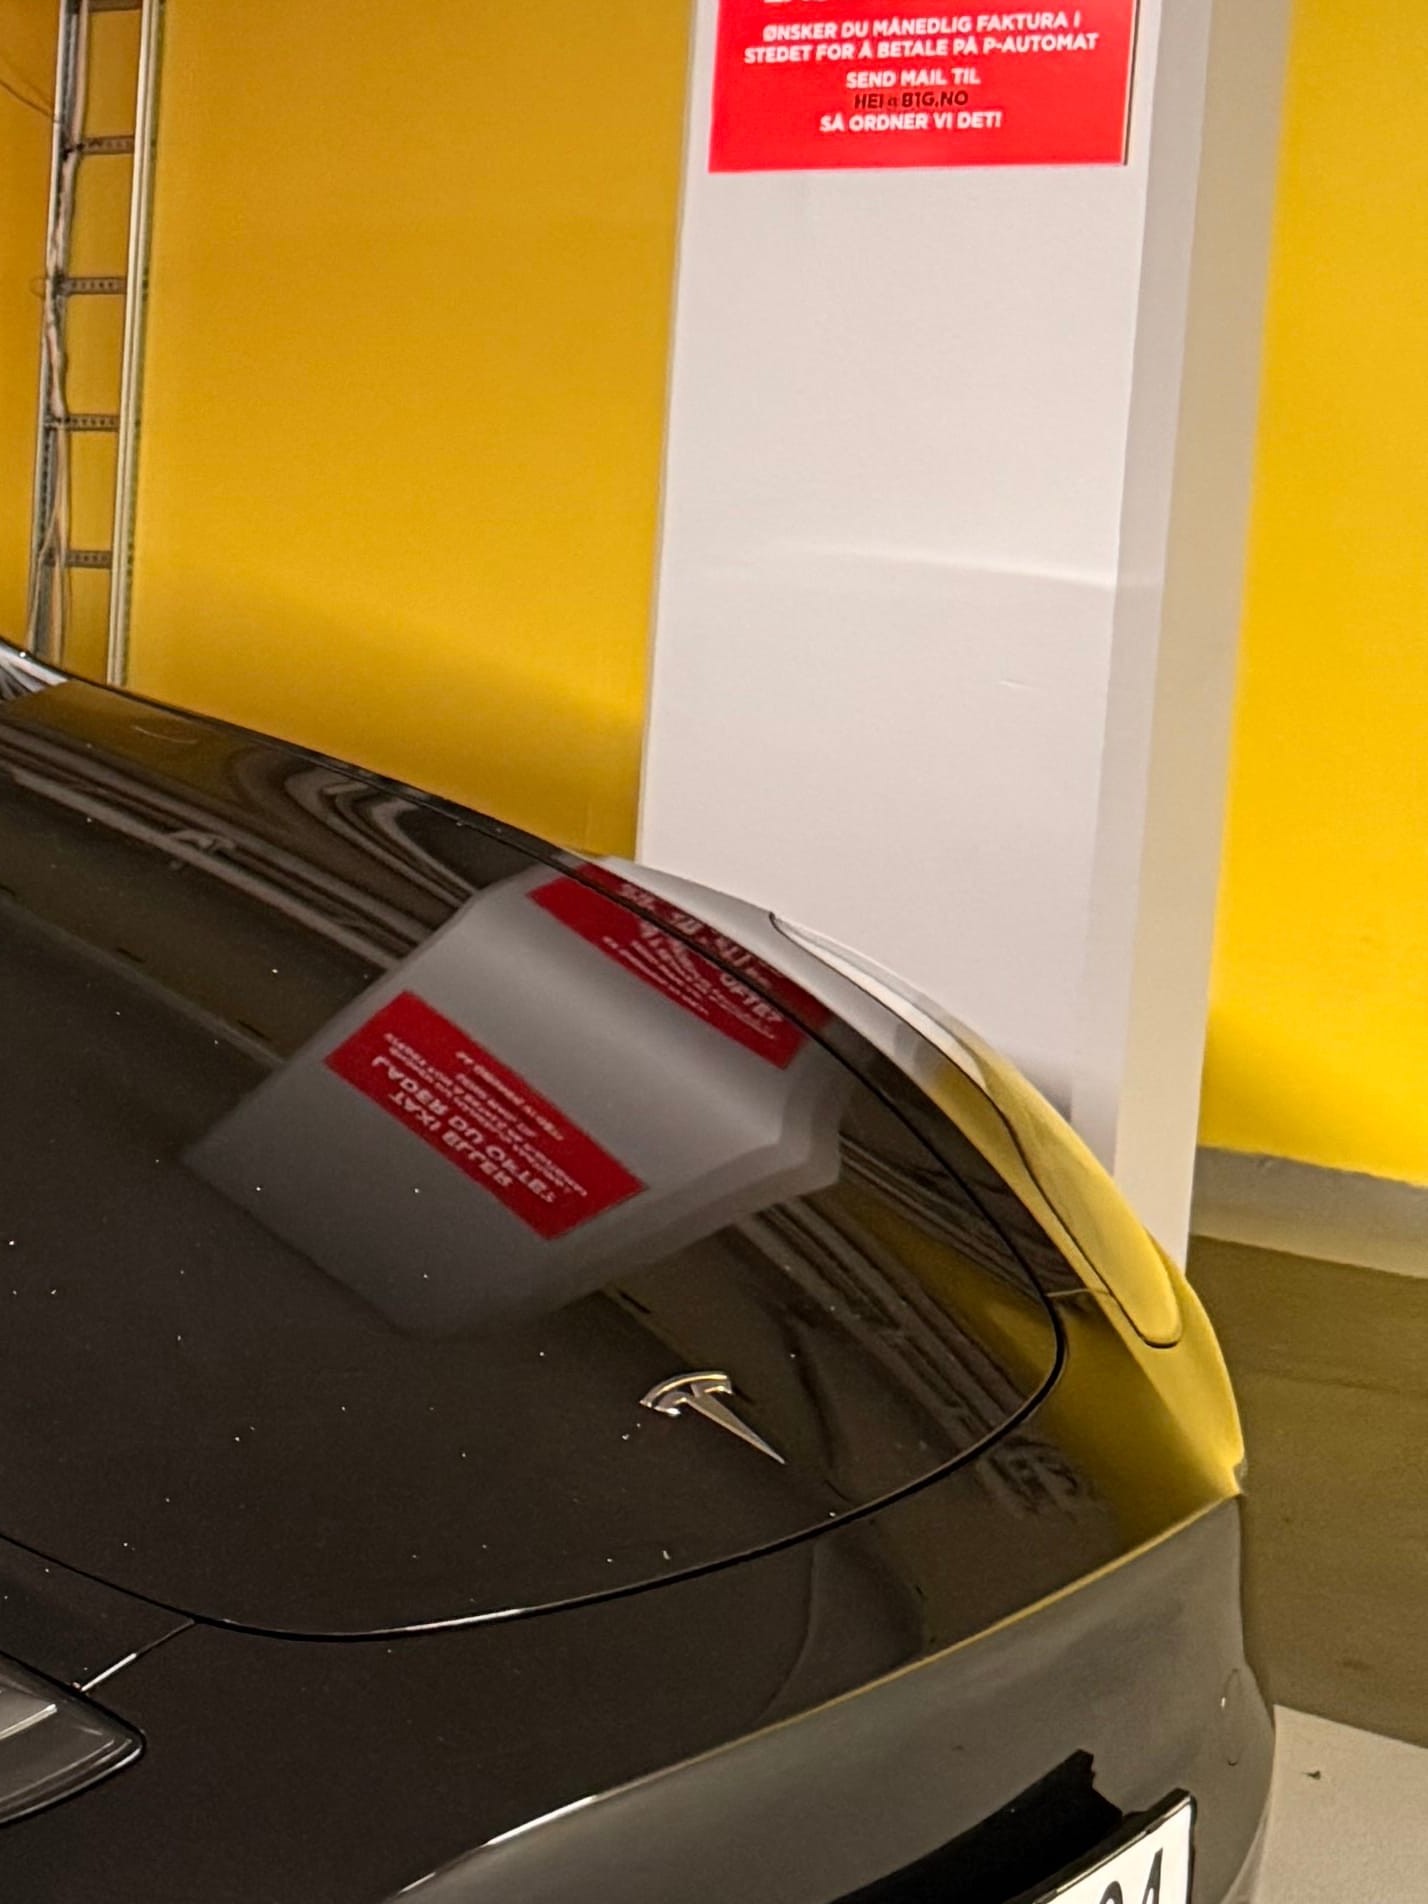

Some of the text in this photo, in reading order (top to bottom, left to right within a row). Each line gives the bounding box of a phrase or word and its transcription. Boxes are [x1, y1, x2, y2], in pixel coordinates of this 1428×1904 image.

[762, 10, 1081, 42] ØNSKER DU MÅNEDLIG FAKTURA I
[744, 33, 1099, 64] STEDET FOR Å BETALE PÅ P-AUTOMAT
[846, 67, 981, 88] SEND MAIL TIL
[819, 112, 844, 132] SÅ
[848, 113, 928, 131] ORDNER
[932, 112, 952, 129] VI
